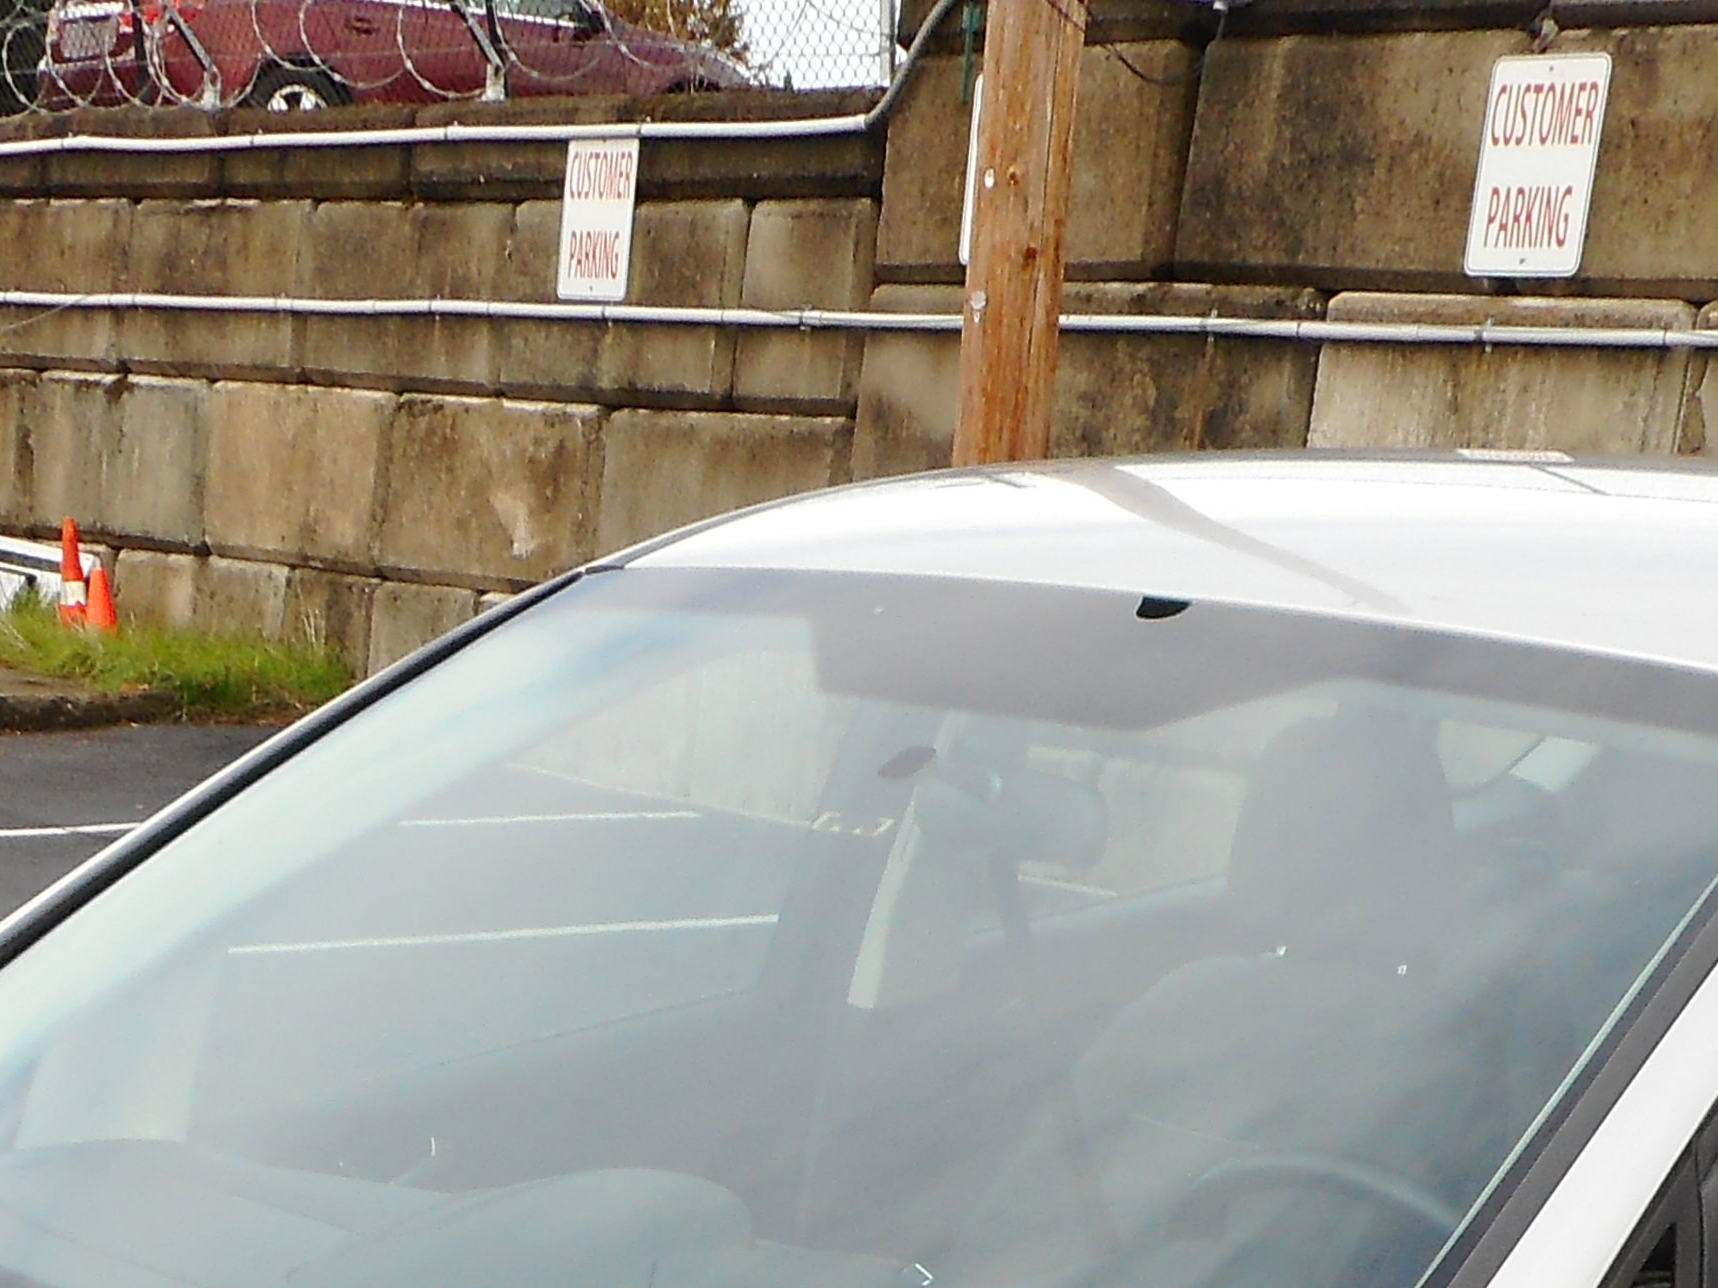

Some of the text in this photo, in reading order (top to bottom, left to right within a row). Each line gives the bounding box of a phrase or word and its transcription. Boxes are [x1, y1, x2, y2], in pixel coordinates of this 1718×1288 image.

[1490, 81, 1599, 147] CUSTOMER
[569, 151, 633, 200] CUSTOMER
[1482, 185, 1573, 248] PARKING
[567, 230, 620, 280] PARKING
